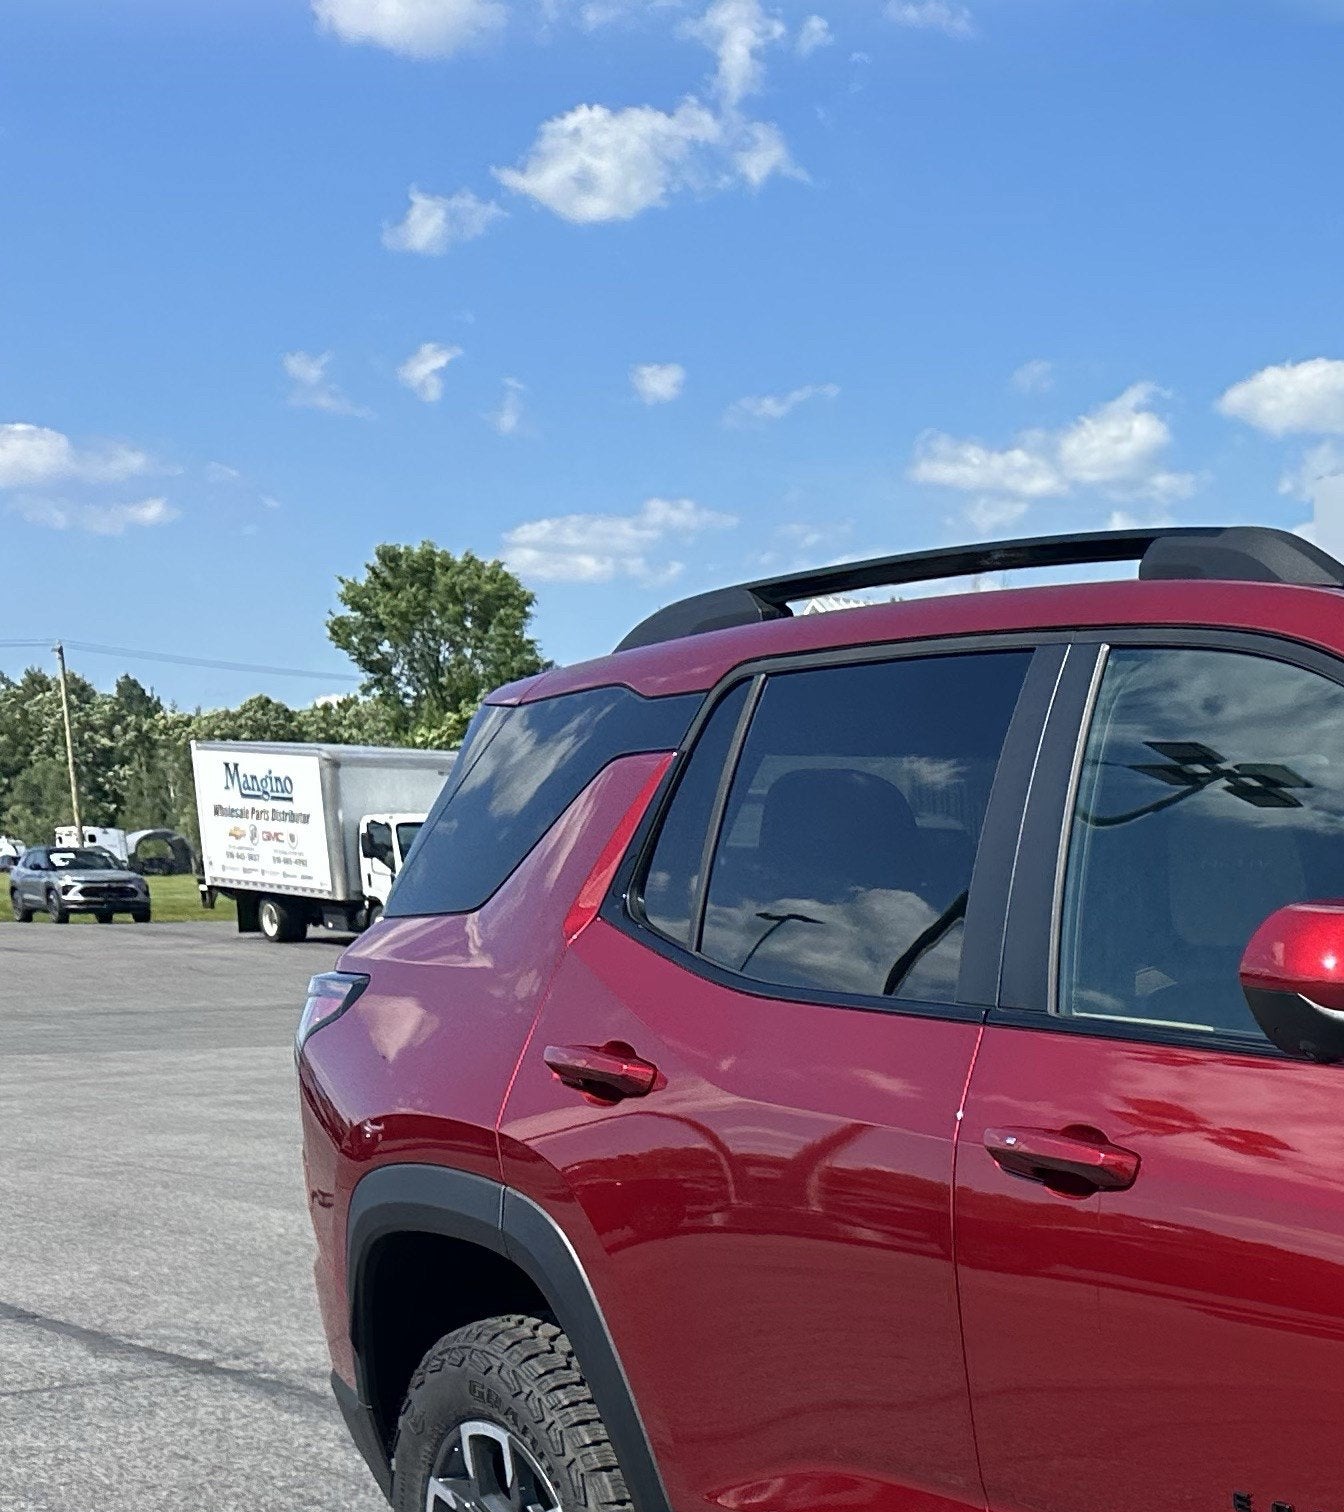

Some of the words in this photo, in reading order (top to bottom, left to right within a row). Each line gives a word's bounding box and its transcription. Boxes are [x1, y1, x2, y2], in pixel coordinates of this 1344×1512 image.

[223, 762, 294, 801] Mangino
[251, 806, 270, 821] Parts
[261, 830, 285, 843] GMC
